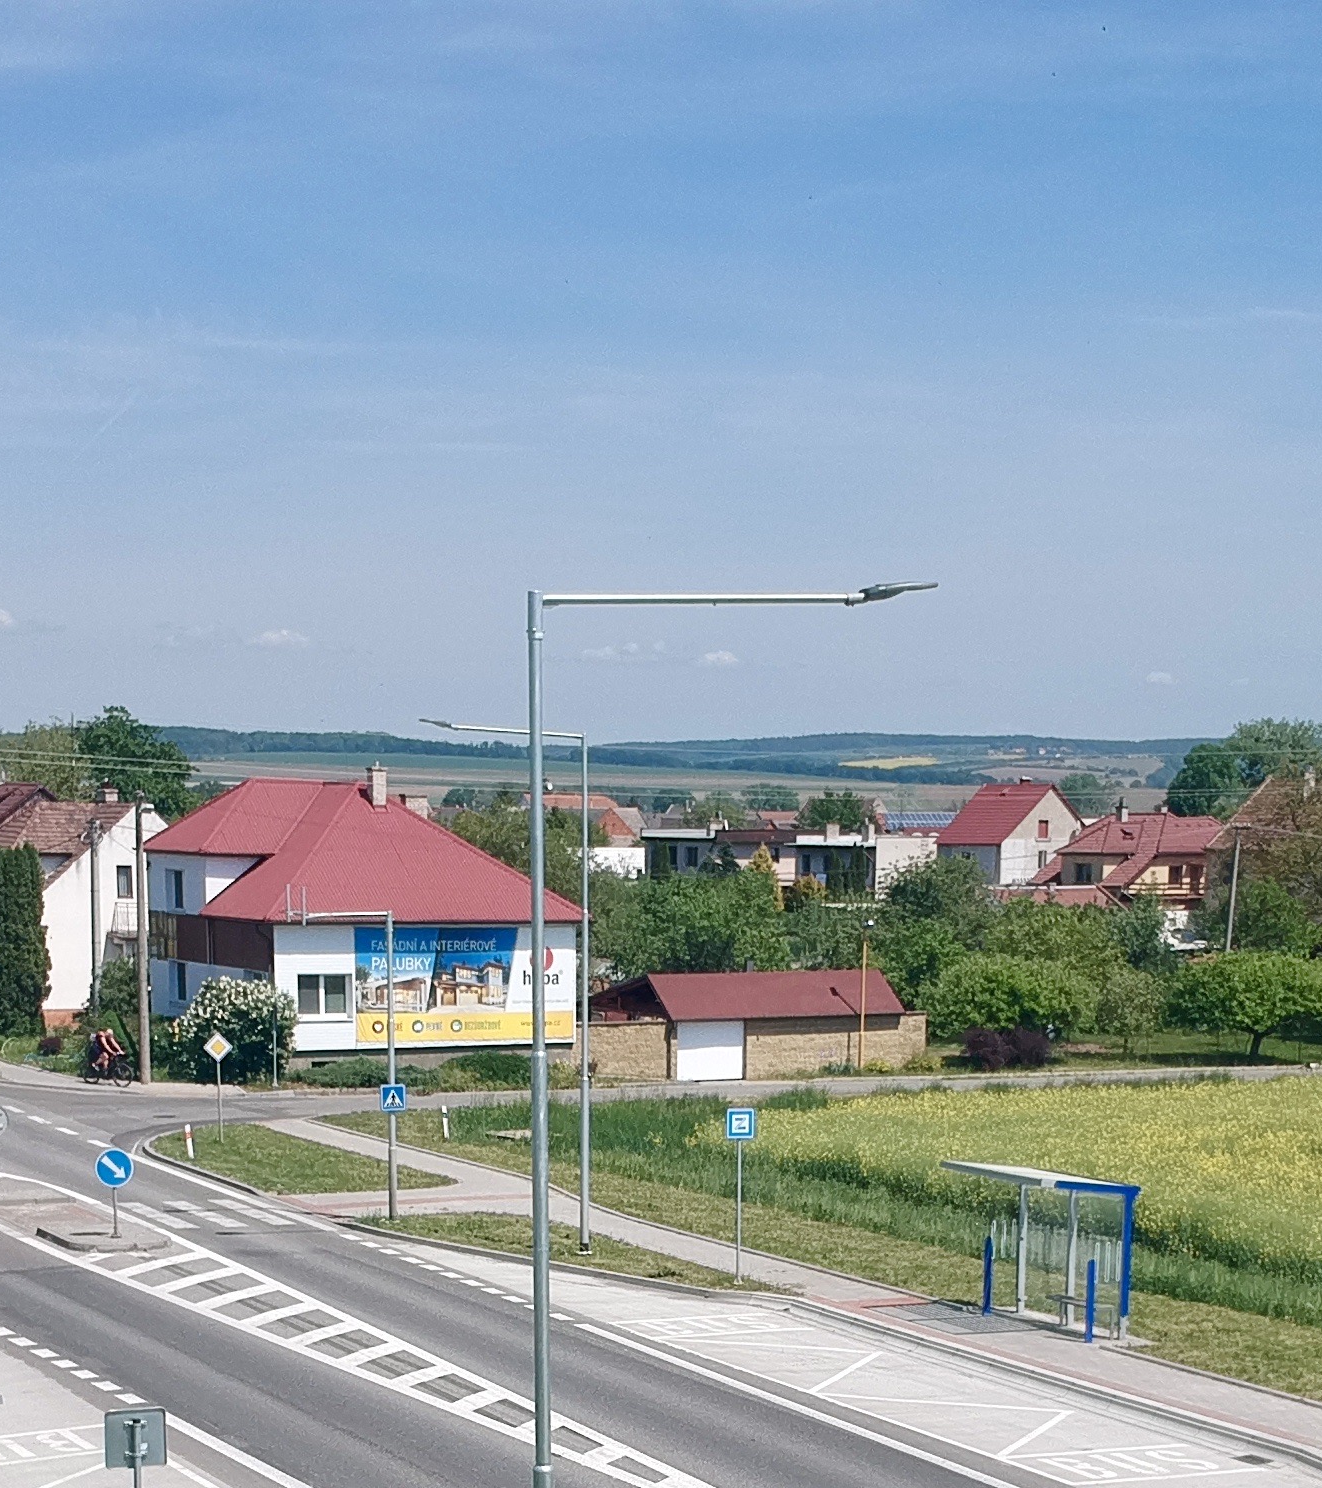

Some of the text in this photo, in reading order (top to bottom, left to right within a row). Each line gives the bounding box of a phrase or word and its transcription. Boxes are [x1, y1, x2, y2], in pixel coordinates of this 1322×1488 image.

[420, 941, 428, 952] A
[430, 938, 497, 952] INTERIÉROVÉ
[638, 1315, 780, 1335] BUS
[1037, 1450, 1219, 1479] BUS
